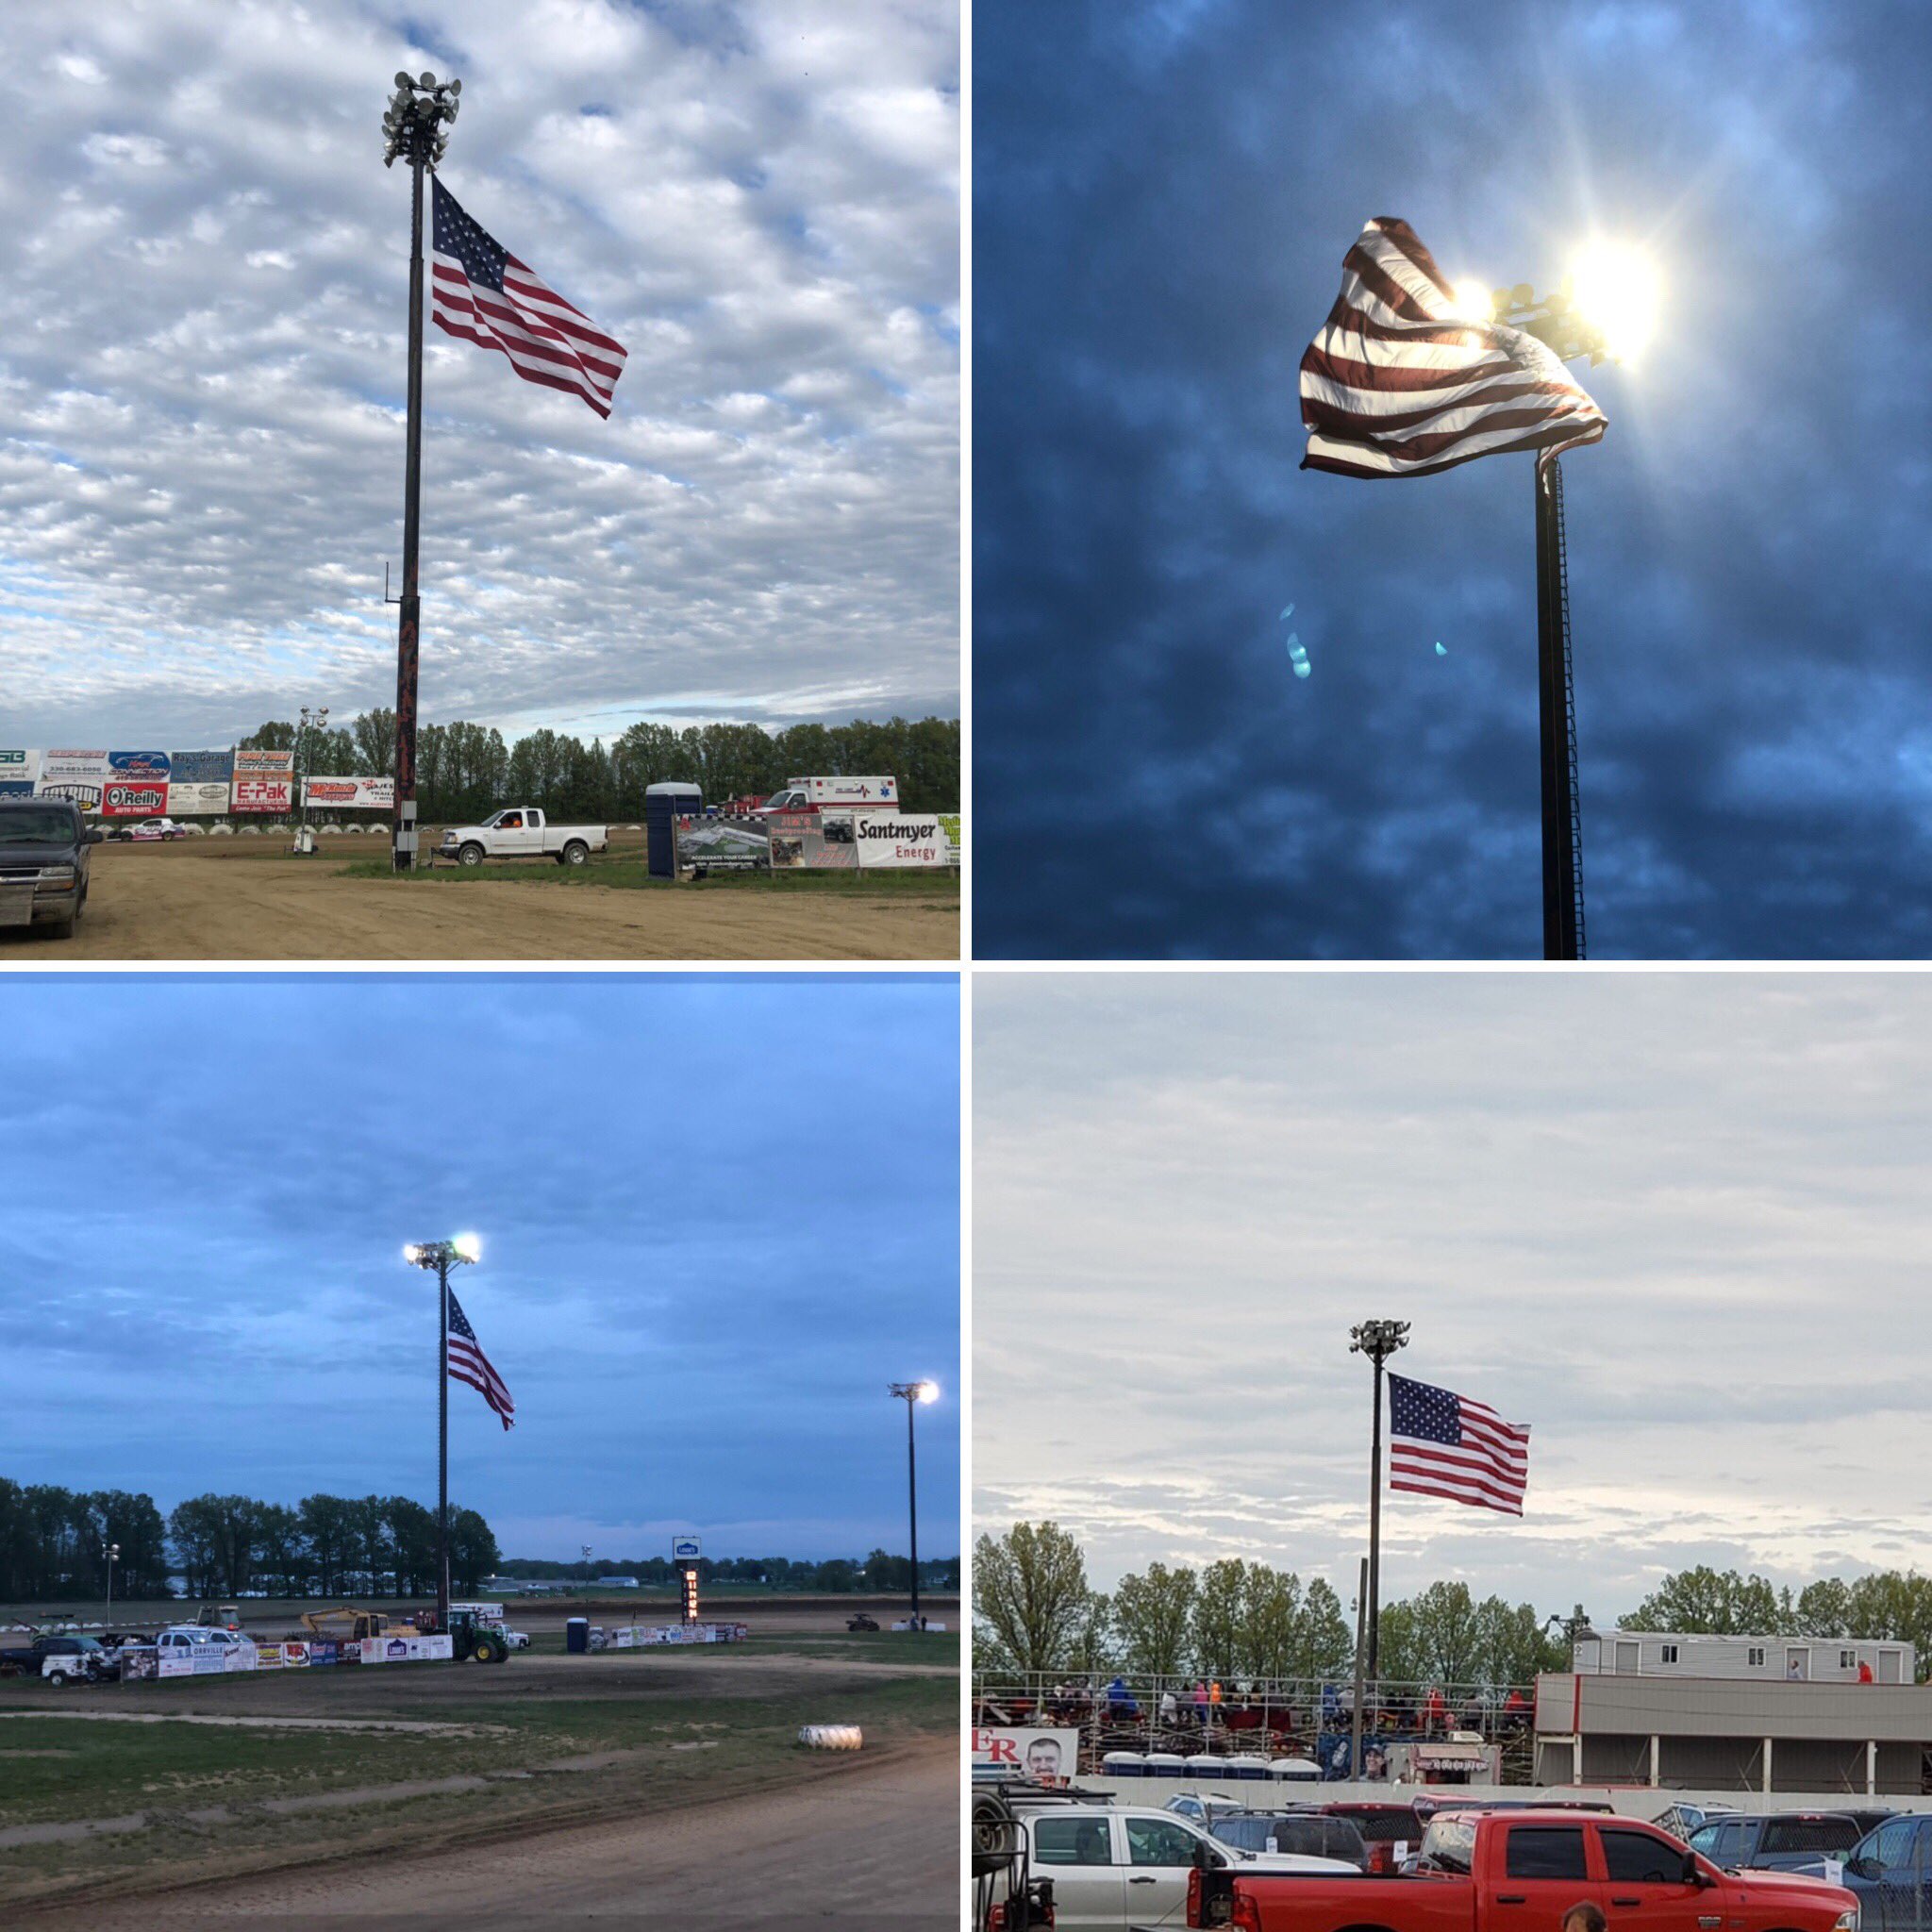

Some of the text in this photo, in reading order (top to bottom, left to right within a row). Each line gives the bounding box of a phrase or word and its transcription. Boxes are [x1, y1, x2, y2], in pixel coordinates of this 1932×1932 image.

[200, 753, 229, 763] Garage
[107, 787, 163, 808] O'Reilly
[237, 782, 287, 799] E-Pak
[858, 820, 936, 842] Santmyer
[896, 845, 936, 860] Energy
